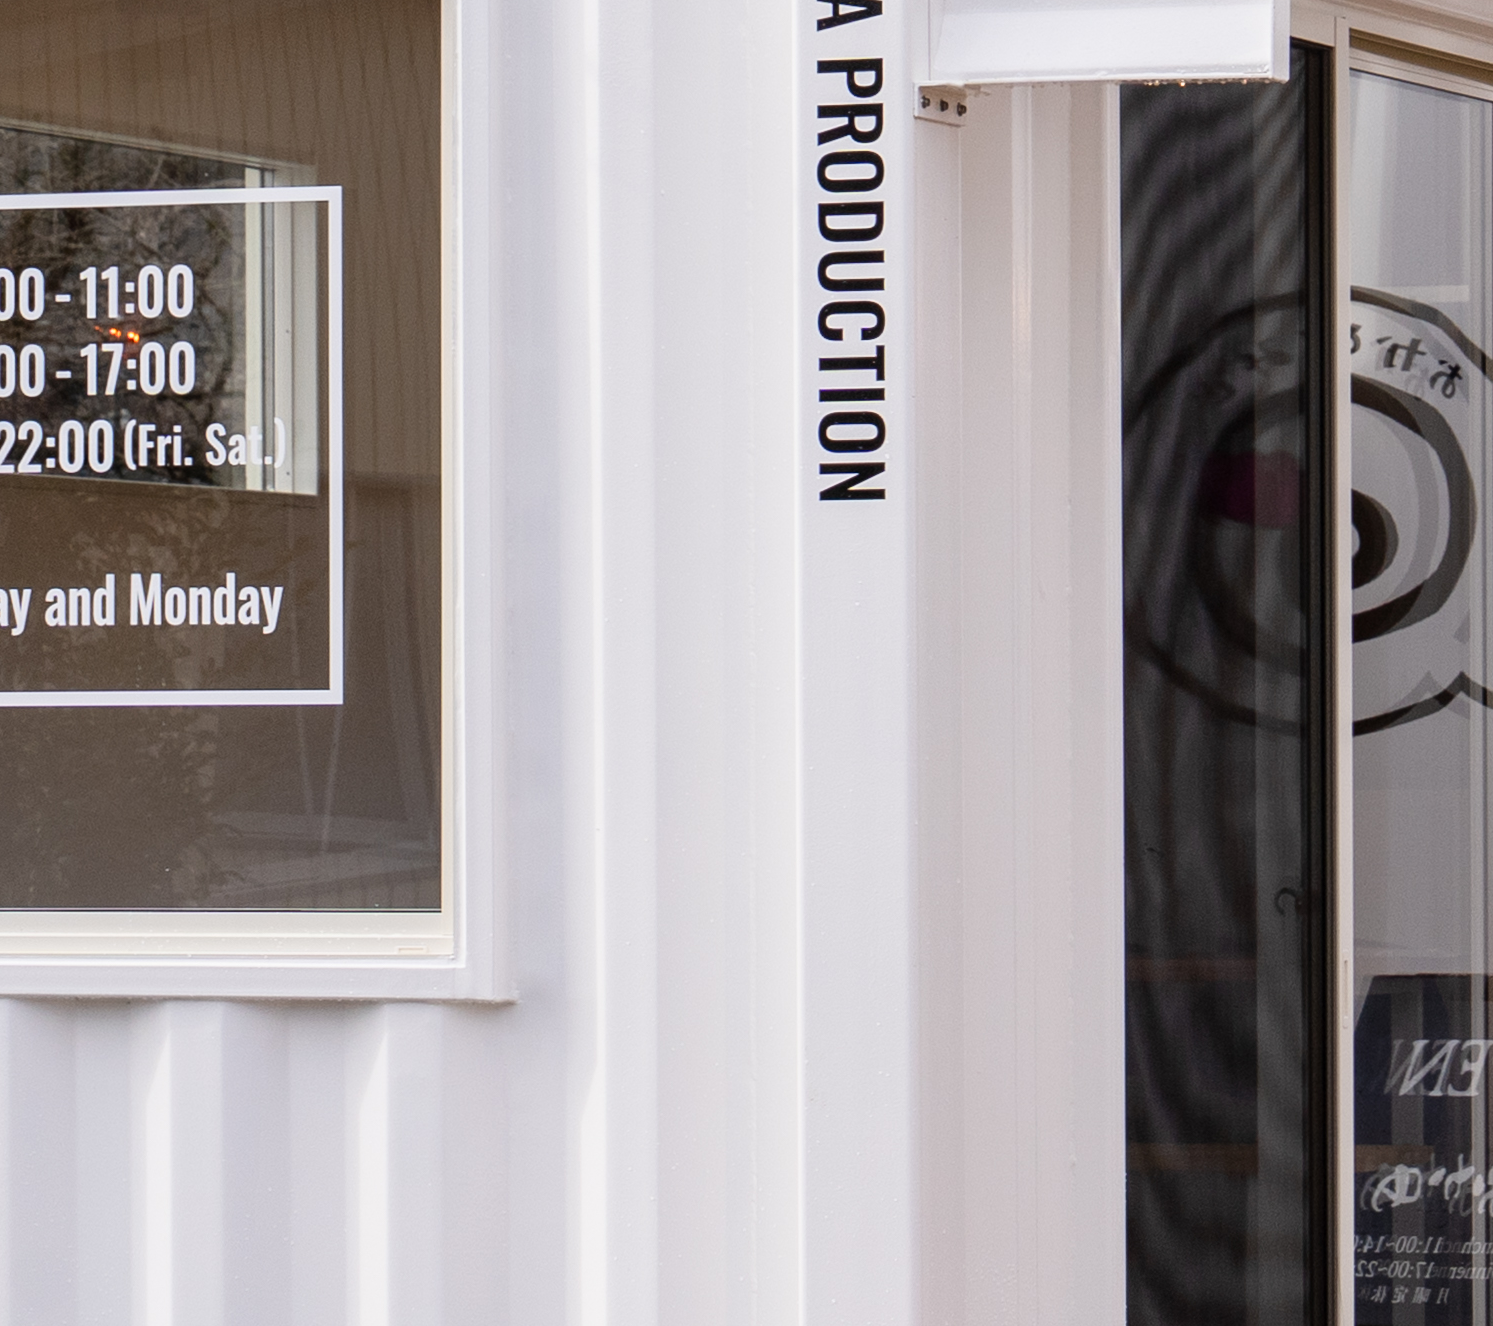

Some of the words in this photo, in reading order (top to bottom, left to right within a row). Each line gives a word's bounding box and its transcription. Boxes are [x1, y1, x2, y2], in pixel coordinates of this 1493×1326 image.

[816, 57, 886, 501] PRODUCTION
[124, 423, 193, 472] (Fri.
[44, 575, 116, 626] and
[129, 572, 284, 635] Monday
